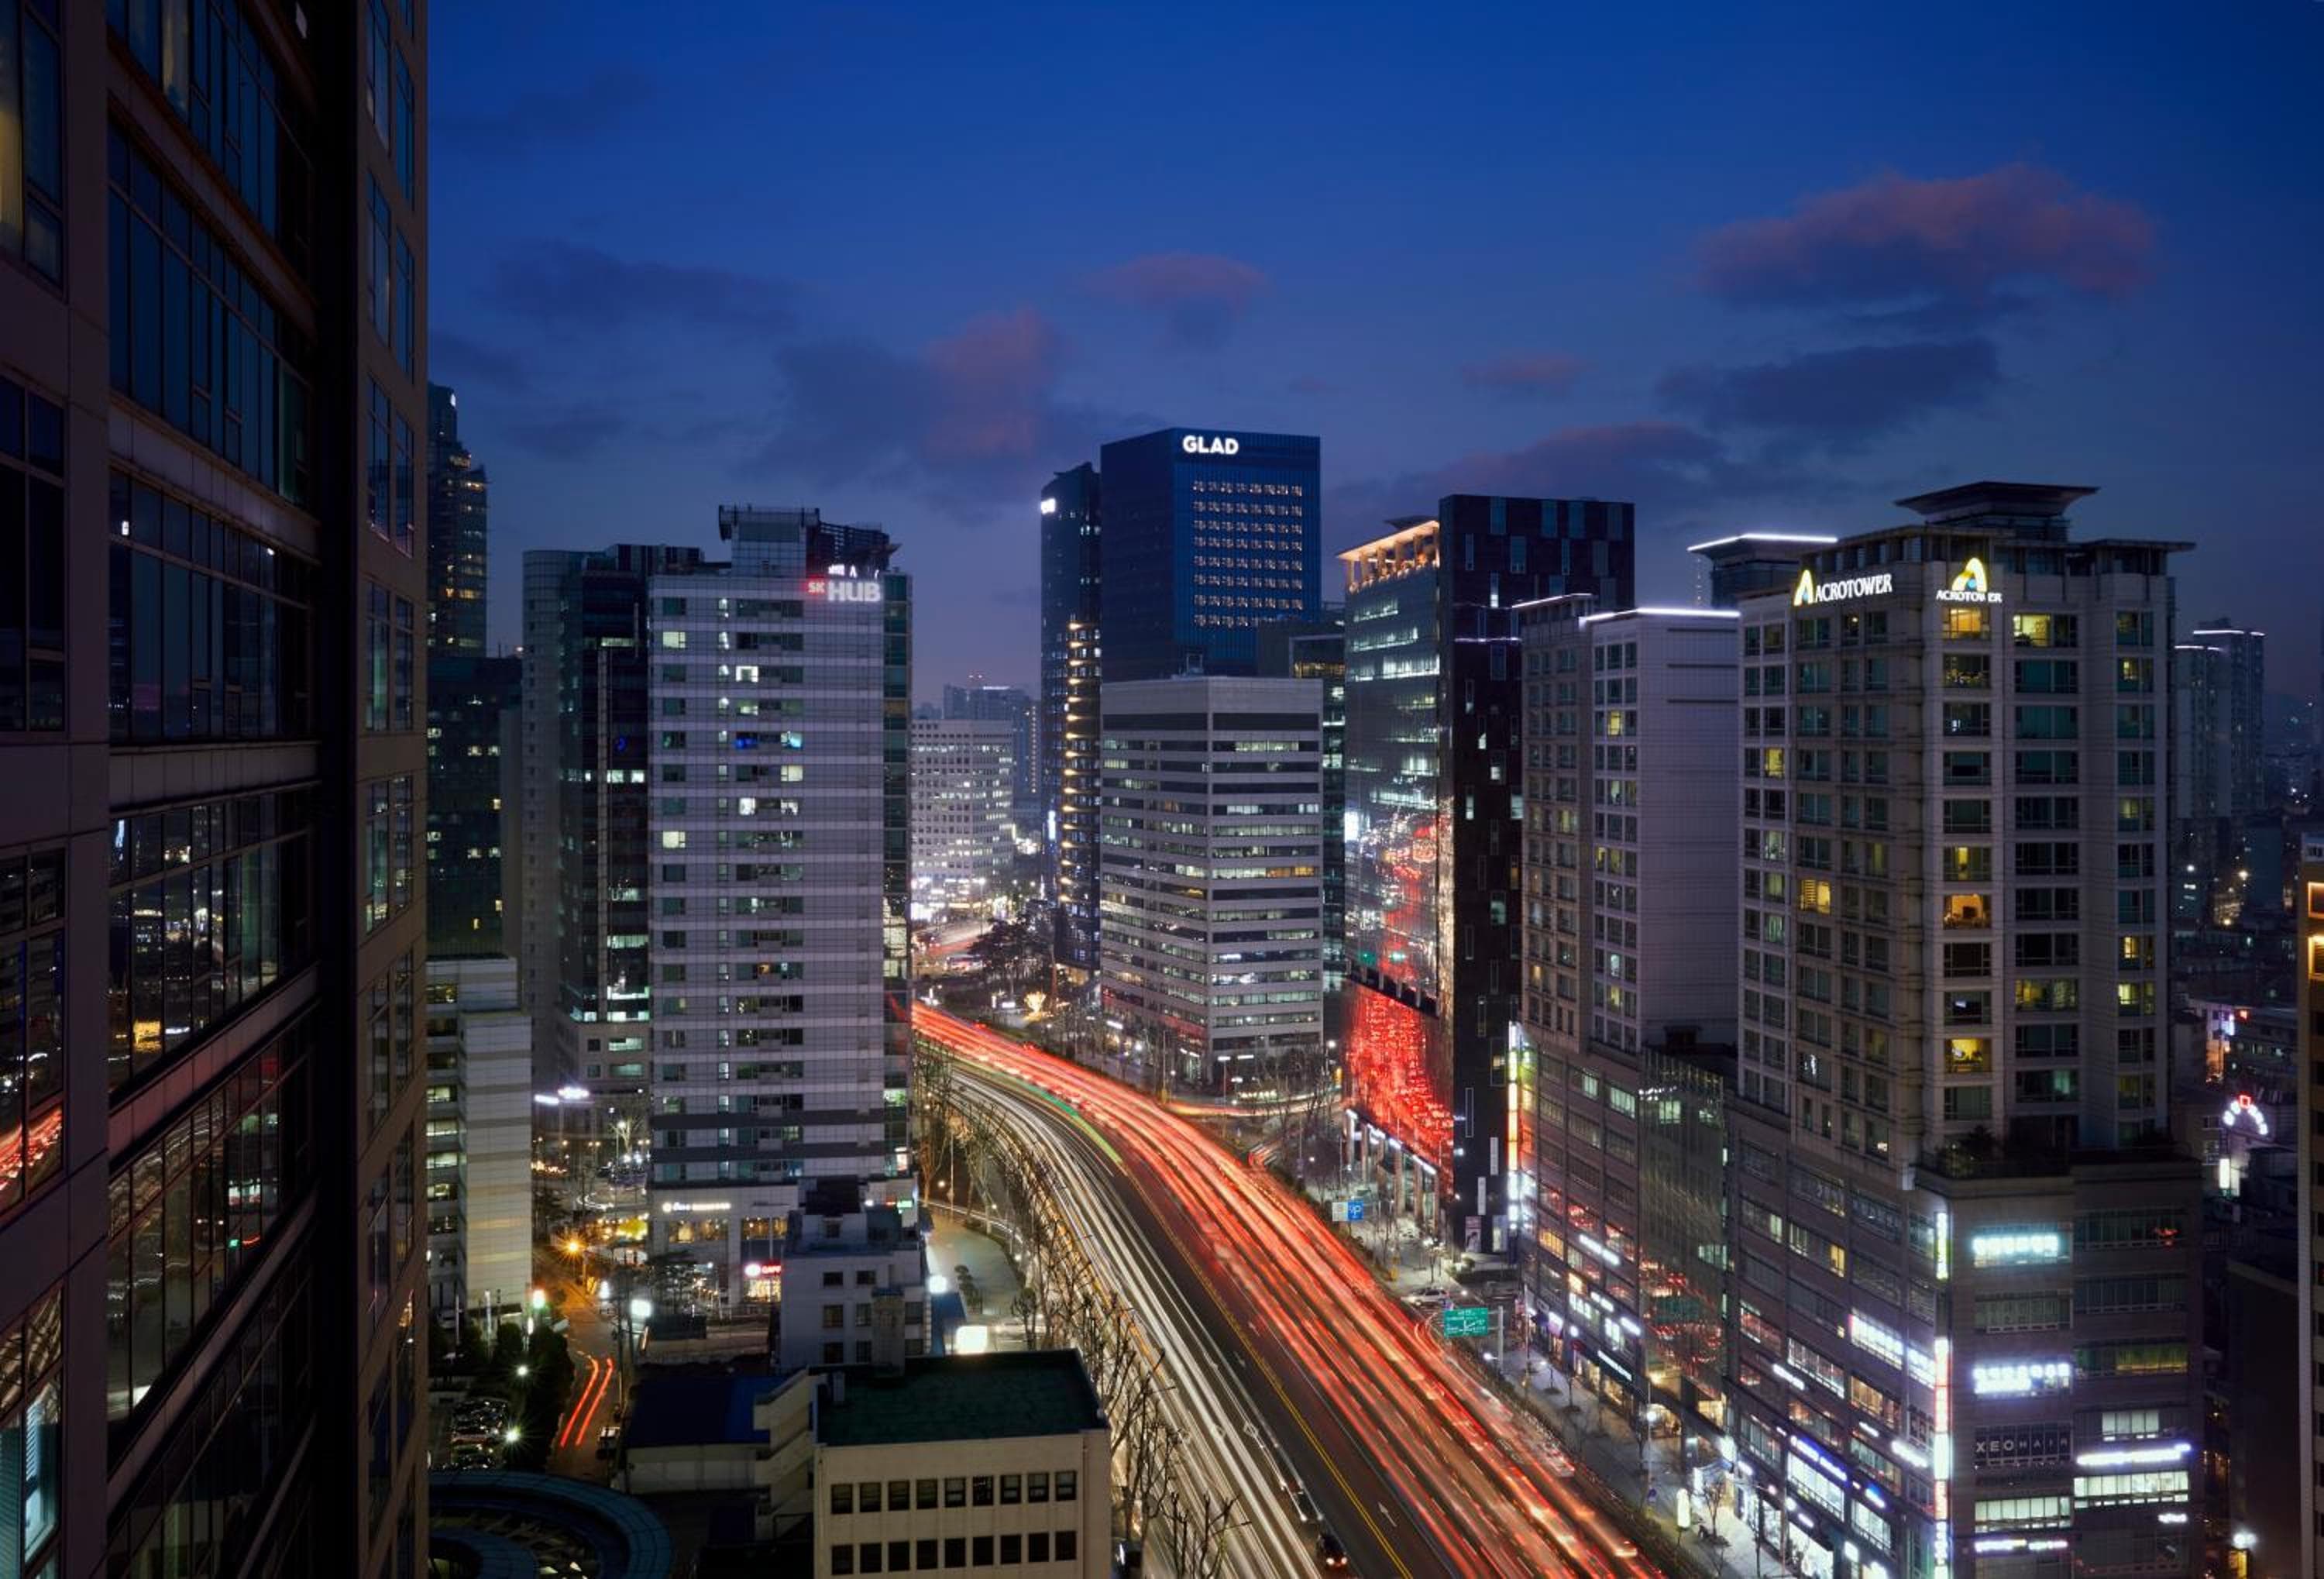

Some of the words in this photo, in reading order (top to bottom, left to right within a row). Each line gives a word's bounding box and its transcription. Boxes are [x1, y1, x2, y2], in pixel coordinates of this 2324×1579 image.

[1183, 435, 1239, 455] GLAD
[808, 582, 826, 594] SK
[828, 582, 881, 602] HUB
[1815, 573, 1893, 603] ACROTOWER
